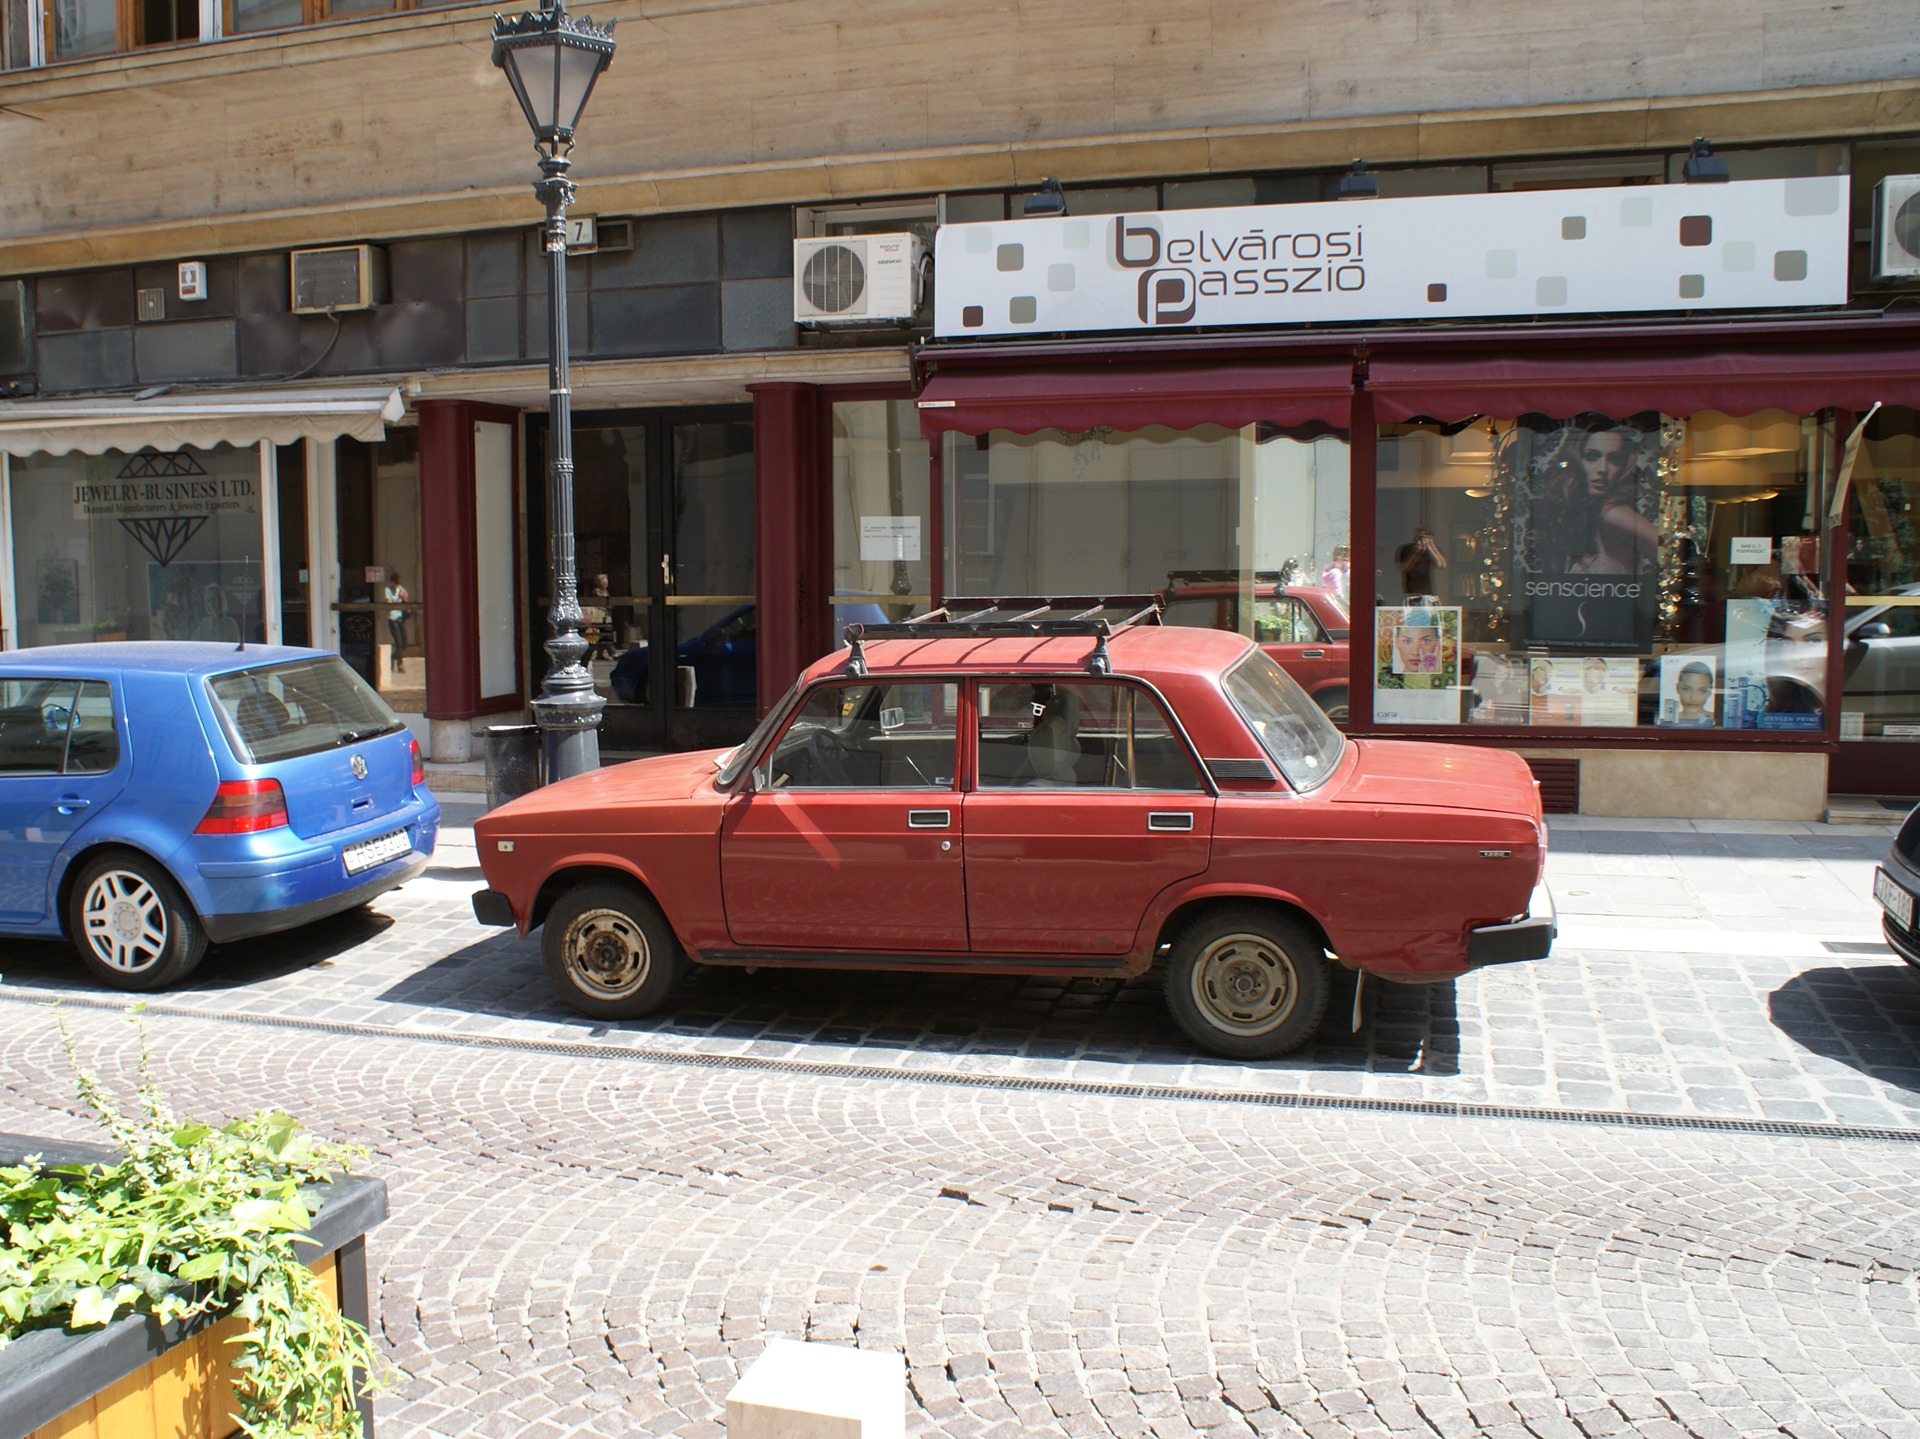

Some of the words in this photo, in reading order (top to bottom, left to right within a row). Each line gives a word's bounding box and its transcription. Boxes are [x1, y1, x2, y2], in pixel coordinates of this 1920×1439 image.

[574, 222, 584, 242] 7
[74, 480, 217, 504] JEWELRY-BUSINESS
[220, 479, 255, 498] LTD.
[1525, 578, 1640, 598] senscience
